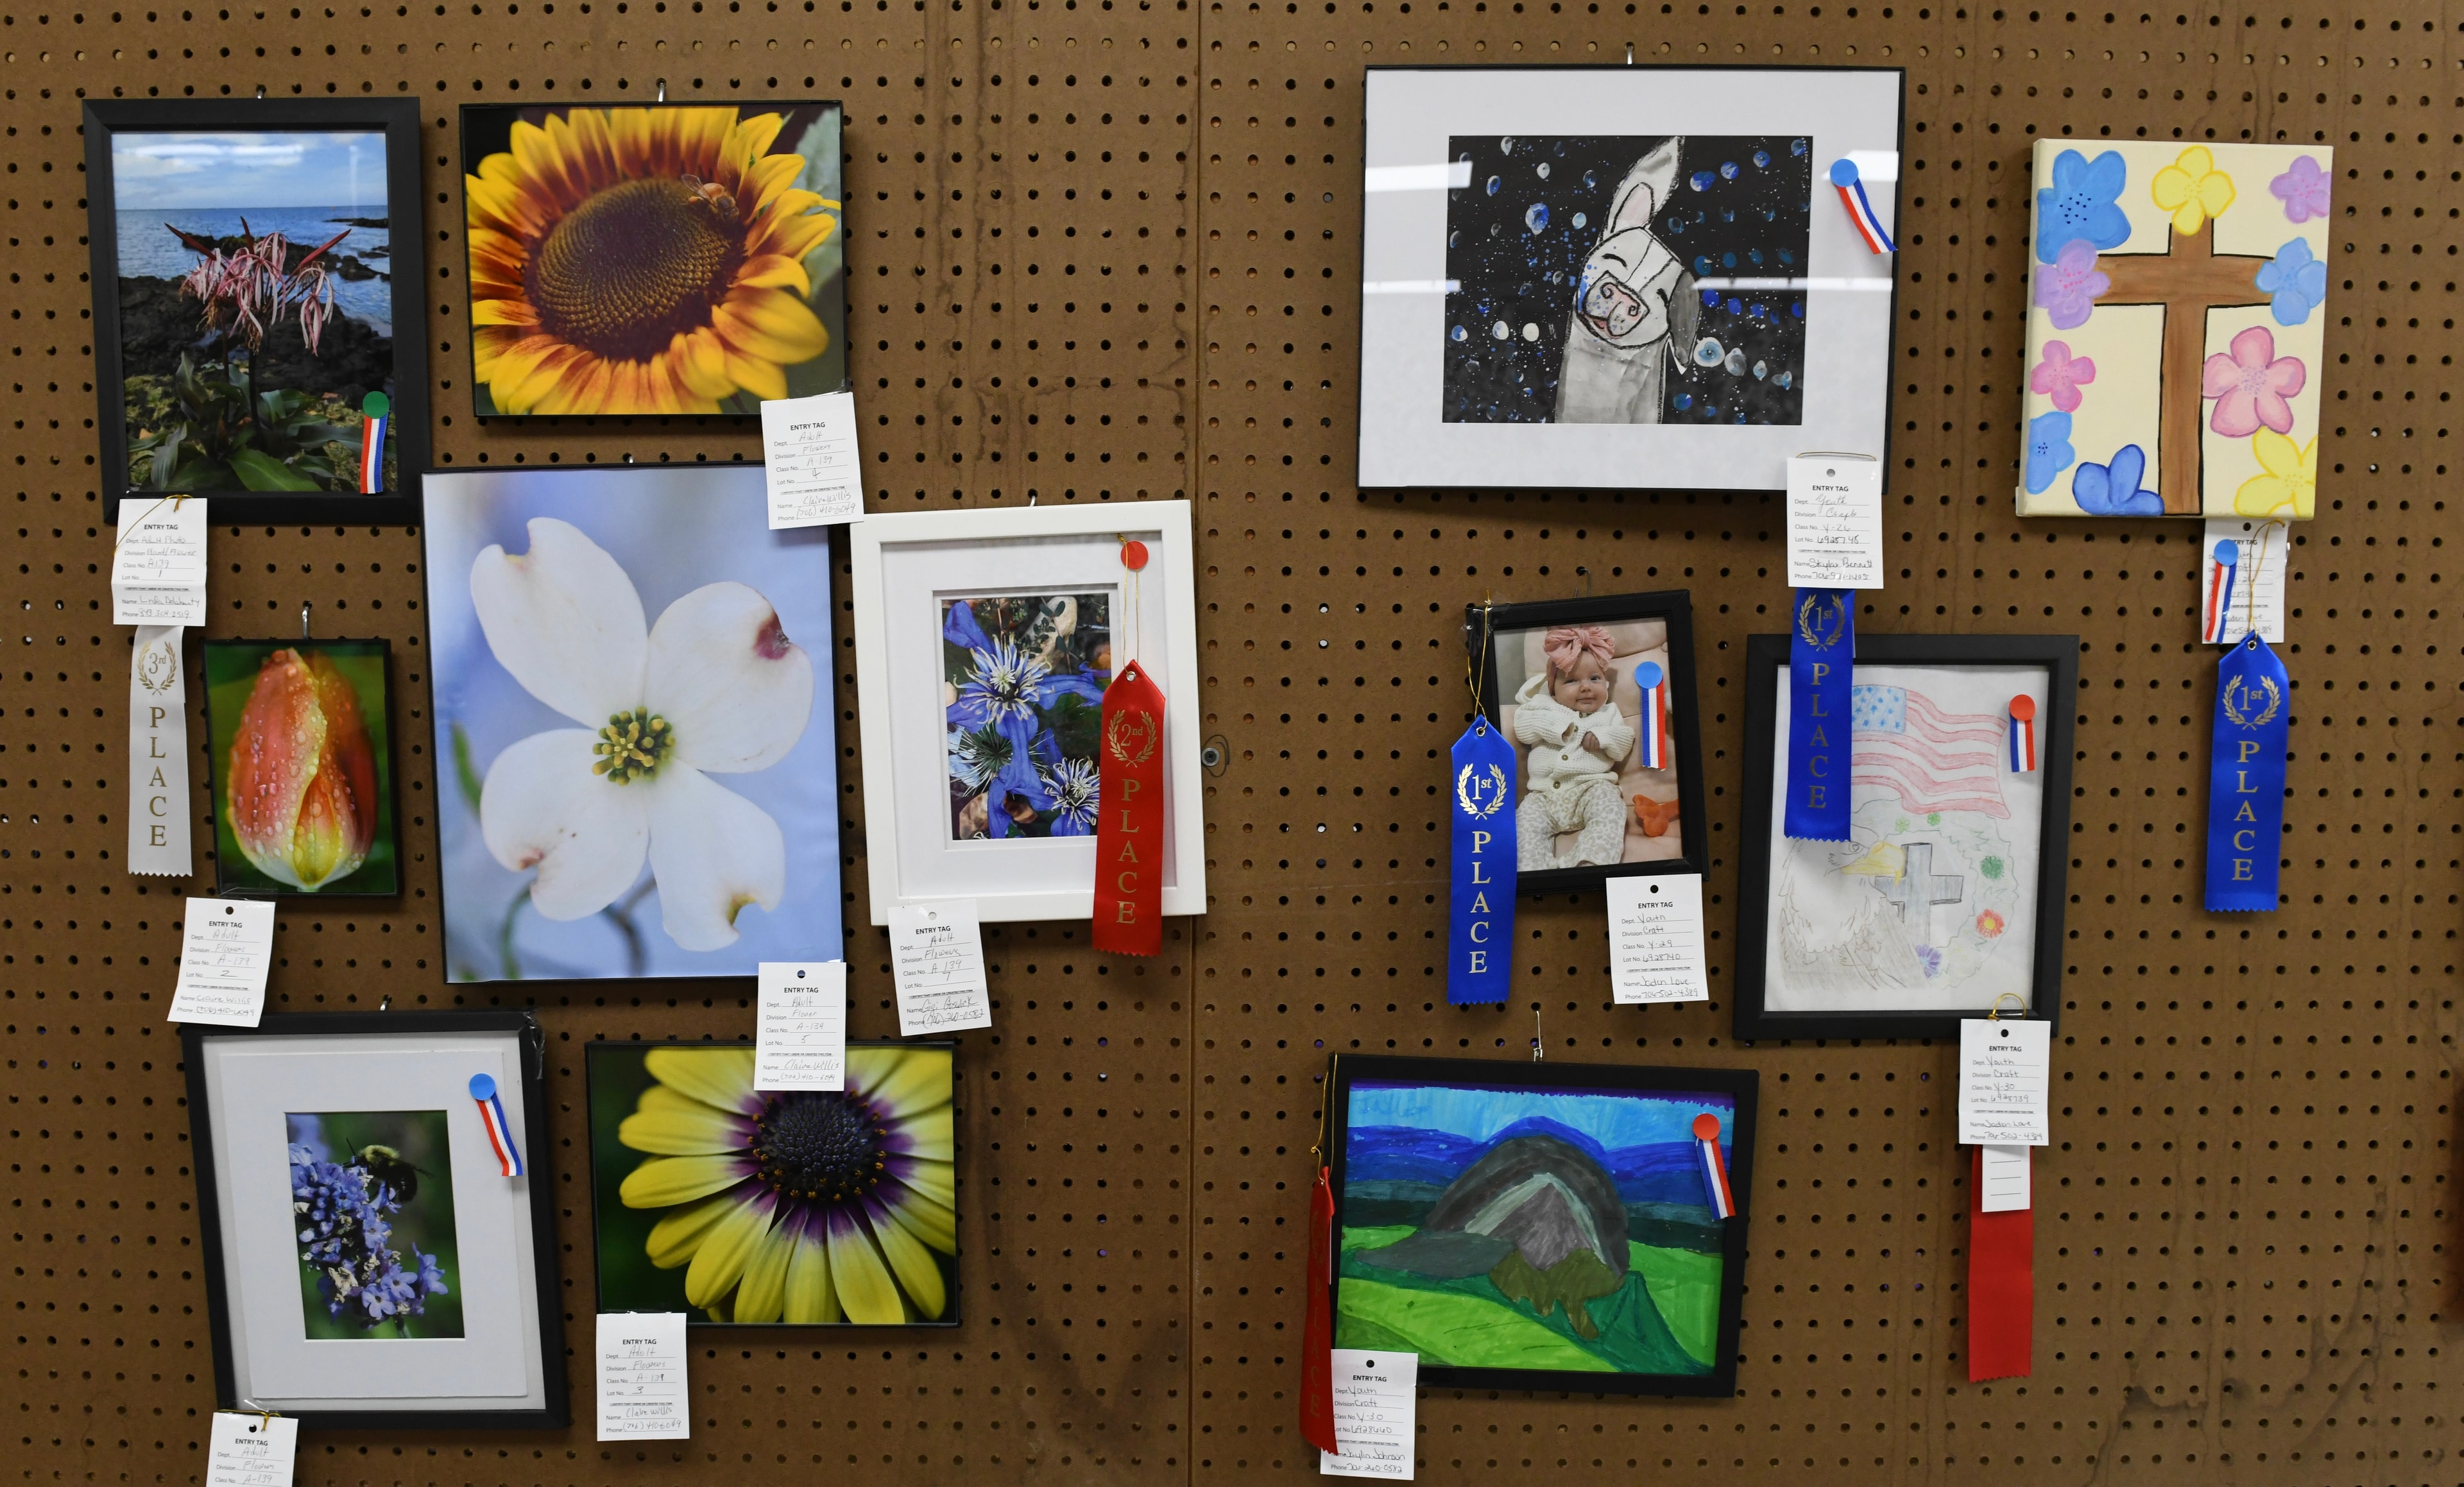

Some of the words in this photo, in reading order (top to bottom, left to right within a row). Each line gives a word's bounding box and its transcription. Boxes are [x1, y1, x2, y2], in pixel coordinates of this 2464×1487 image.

[799, 431, 823, 442] Adult
[812, 468, 821, 479] 4
[1814, 606, 1833, 631] 1st
[149, 652, 166, 674] 3rd
[2239, 685, 2263, 711] 1st
[1120, 724, 1143, 747] 2nd
[1808, 663, 1830, 808] PLACE
[149, 706, 167, 847] PLACE
[1471, 774, 1492, 800] 1st
[2232, 740, 2260, 881] PLACE
[1116, 778, 1140, 924] PLACE
[1469, 831, 1491, 974] PLACE
[930, 933, 954, 947] Adult
[1994, 1069, 2019, 1078] Craft
[241, 1445, 270, 1457] Adult
